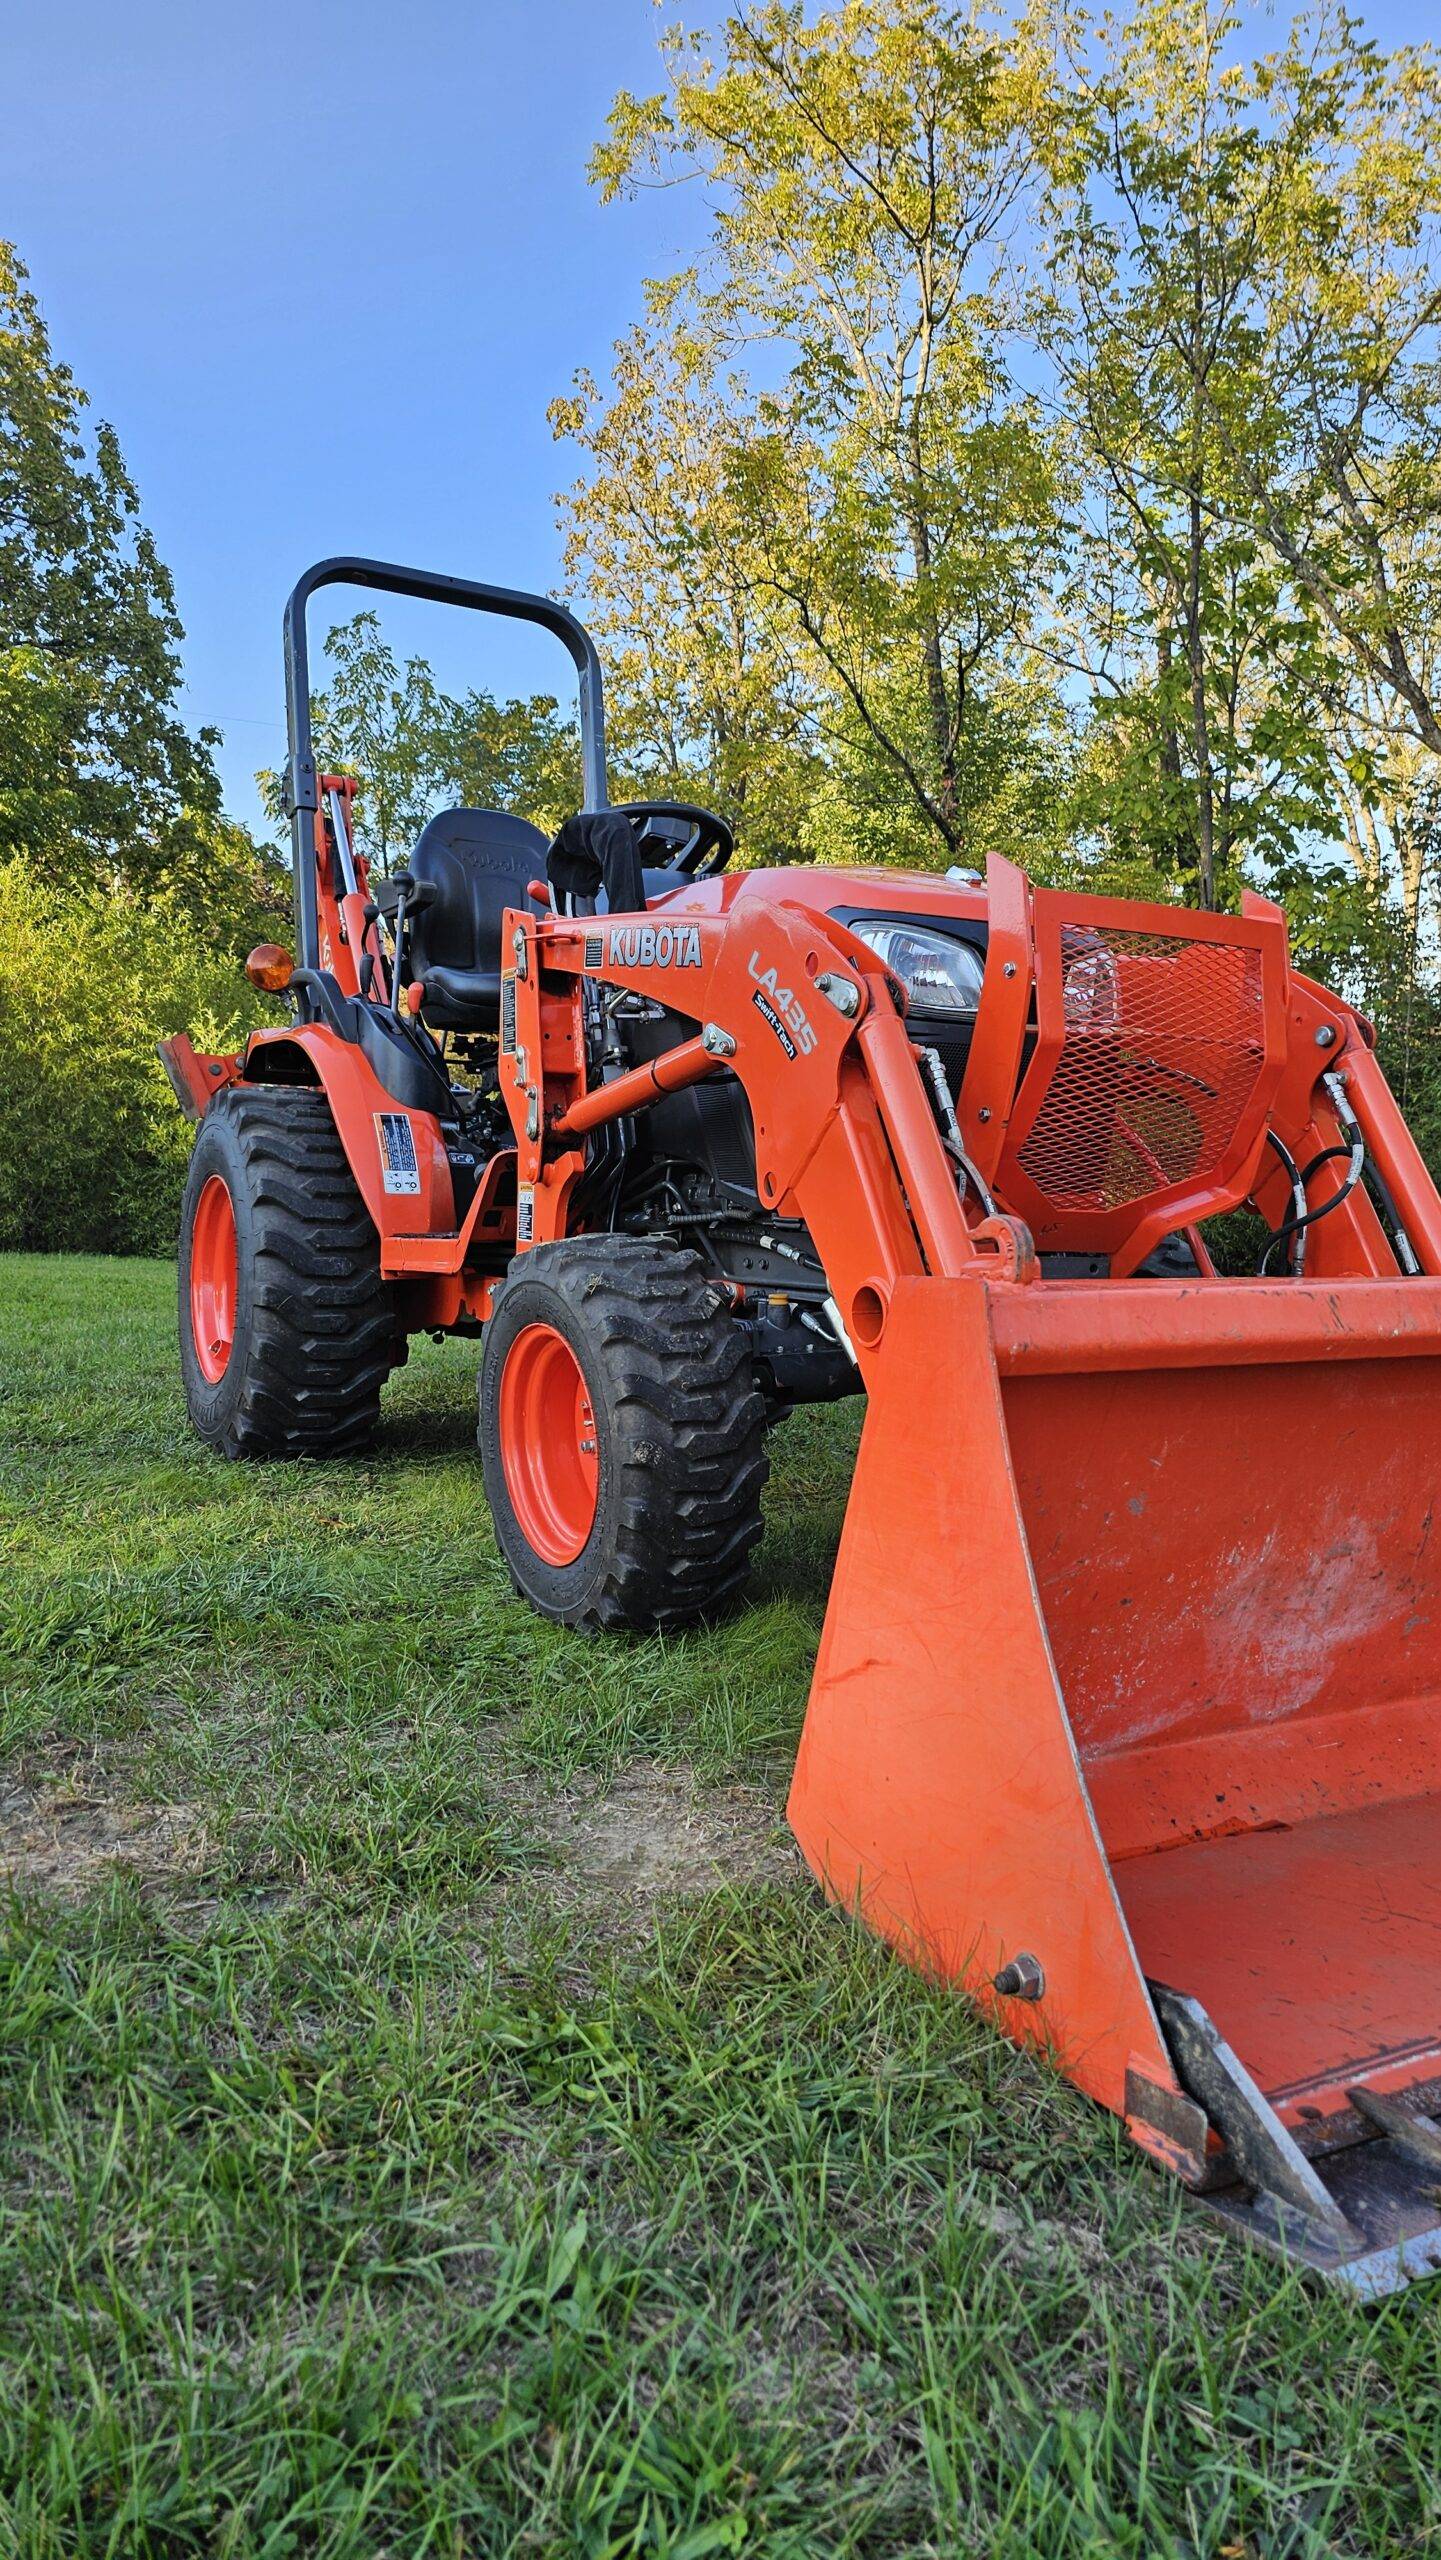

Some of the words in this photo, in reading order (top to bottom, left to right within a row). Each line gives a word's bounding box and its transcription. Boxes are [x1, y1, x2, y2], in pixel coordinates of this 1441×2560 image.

[608, 926, 703, 968] KUBOTA
[748, 950, 818, 1056] LA435
[754, 993, 796, 1058] Swift-Tach
